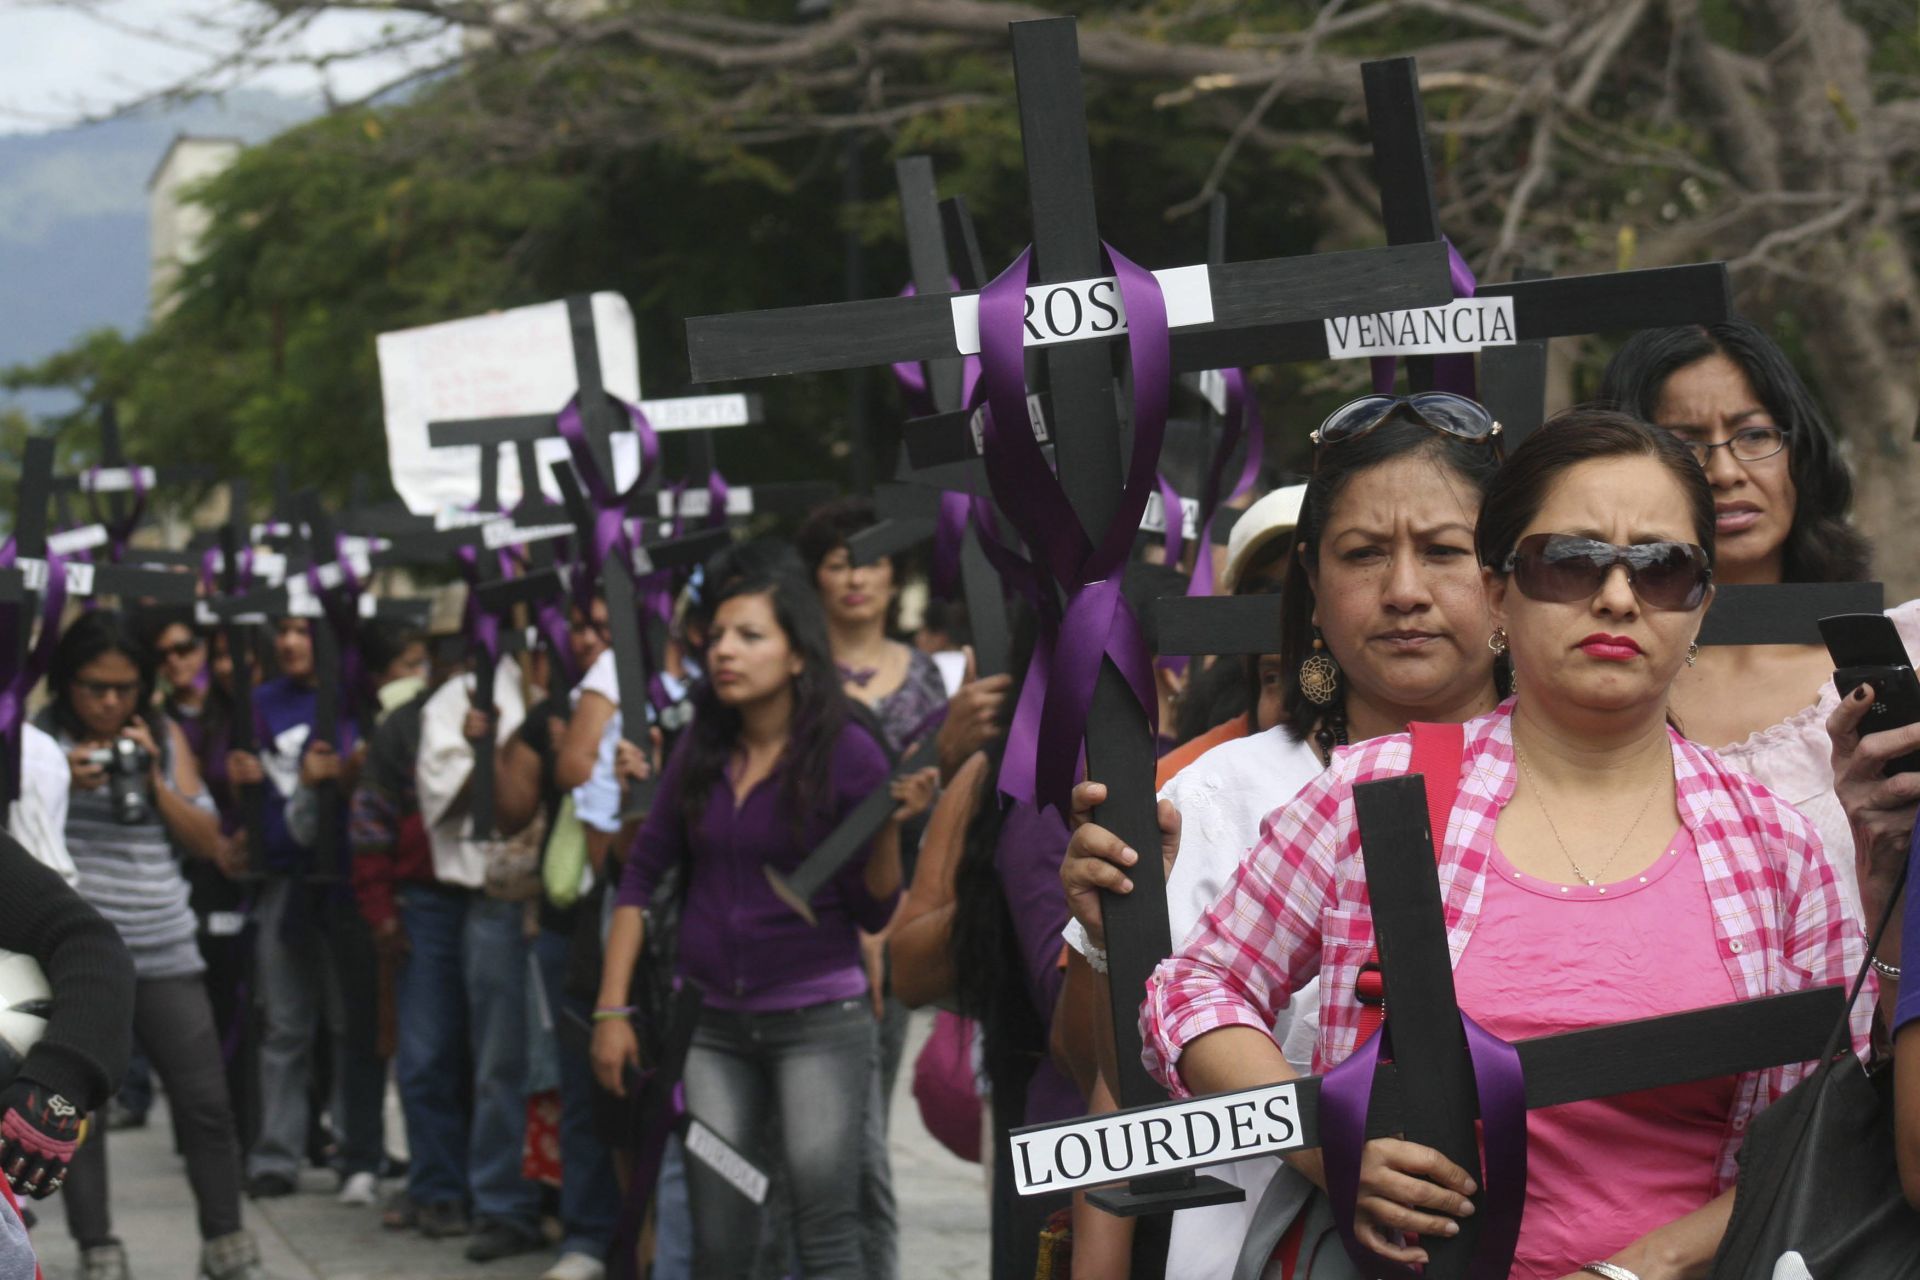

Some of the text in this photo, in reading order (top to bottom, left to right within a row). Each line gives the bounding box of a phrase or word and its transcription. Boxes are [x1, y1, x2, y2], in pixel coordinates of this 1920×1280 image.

[1023, 281, 1129, 340] ROS
[1330, 306, 1514, 350] VENANCIA
[1015, 1095, 1295, 1188] LOURDES
